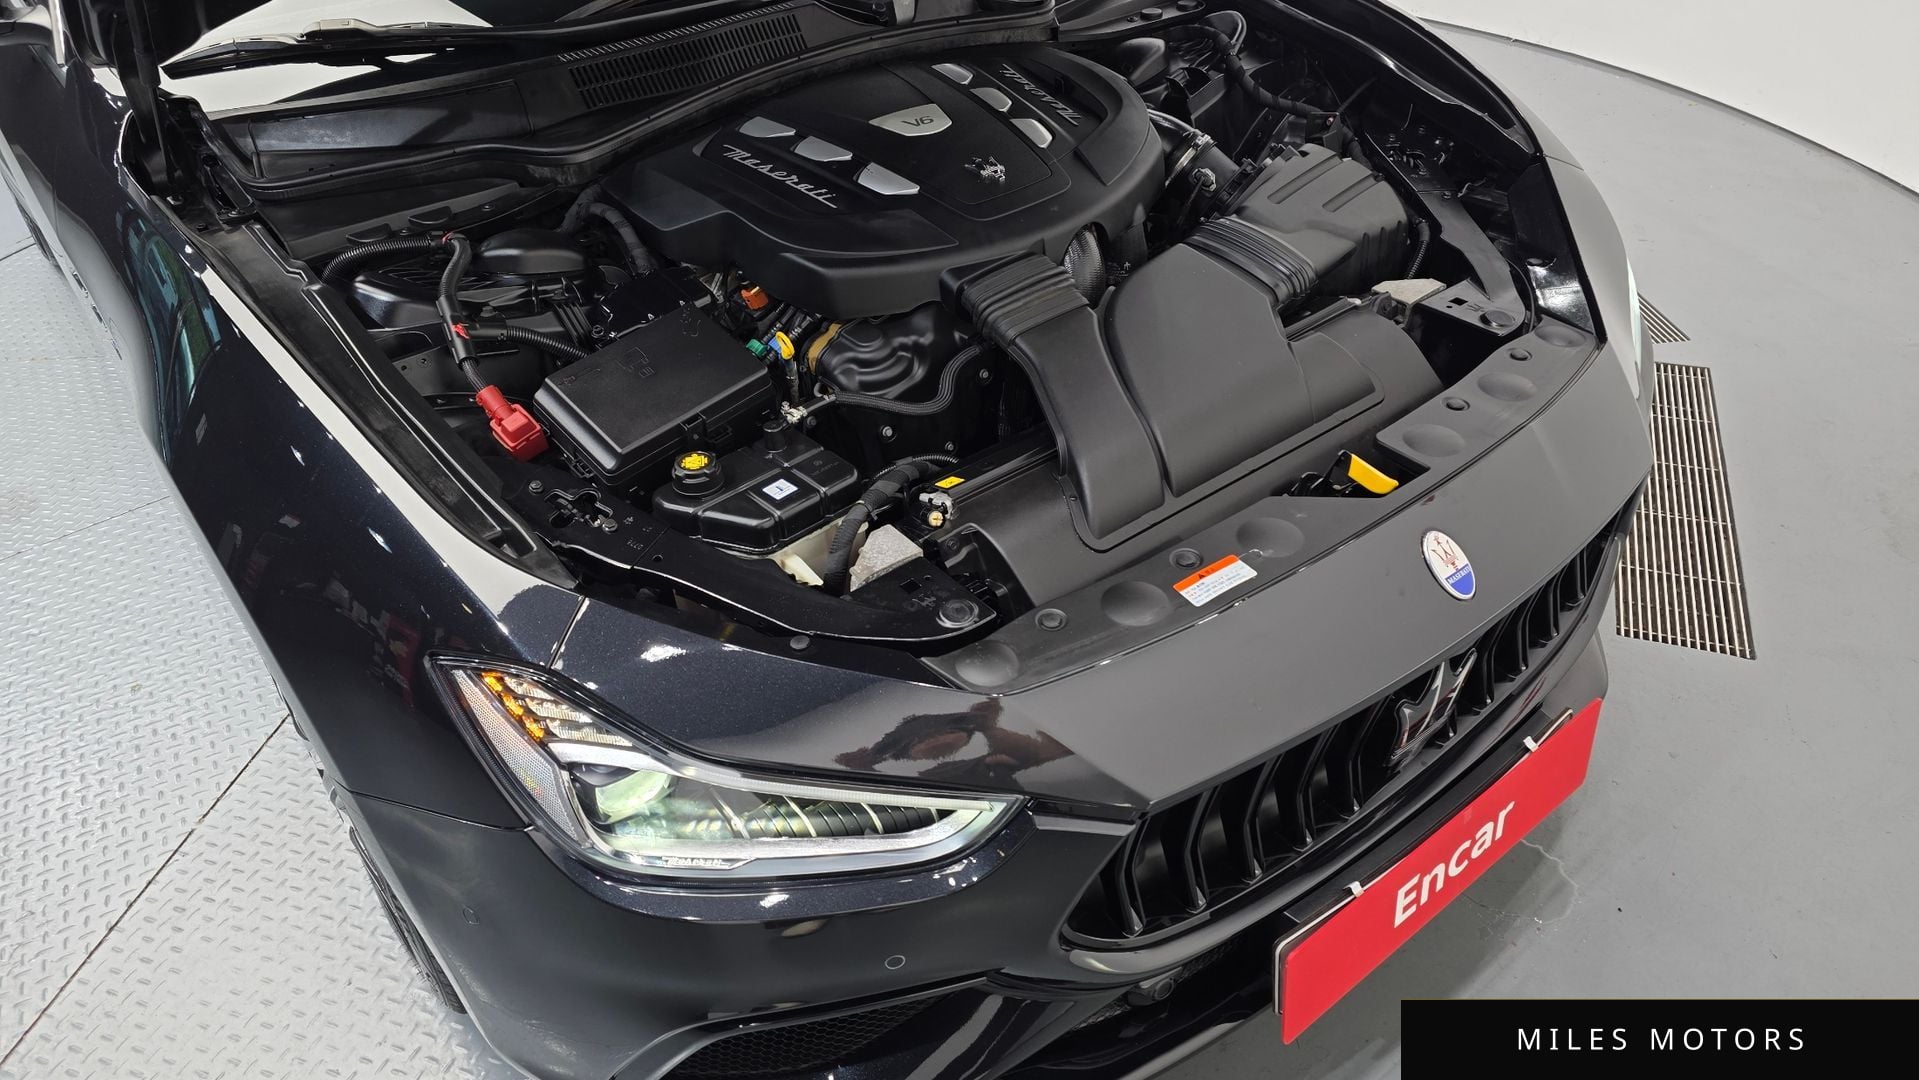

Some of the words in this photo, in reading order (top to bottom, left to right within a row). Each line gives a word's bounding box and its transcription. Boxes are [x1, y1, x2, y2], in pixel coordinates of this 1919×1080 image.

[901, 115, 934, 127] V6
[999, 63, 1082, 126] Maserati
[723, 144, 838, 209] Maserati
[1394, 801, 1516, 929] Encar
